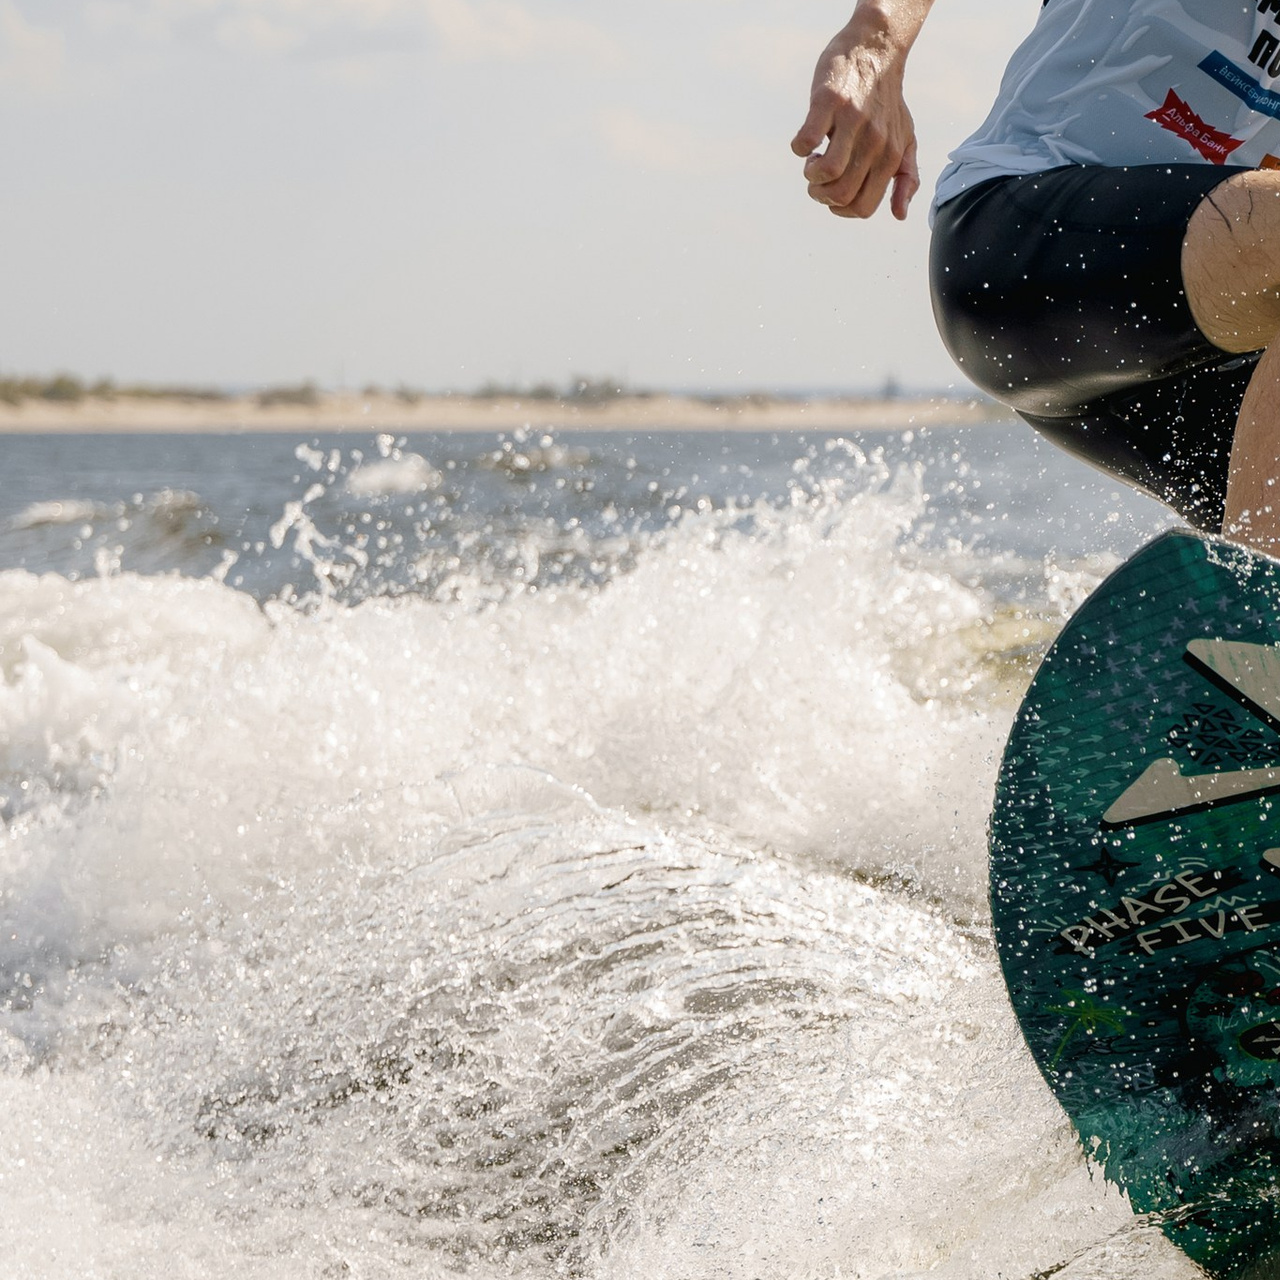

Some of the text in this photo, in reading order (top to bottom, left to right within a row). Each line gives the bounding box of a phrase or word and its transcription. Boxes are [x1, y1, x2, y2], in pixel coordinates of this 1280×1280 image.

[1163, 107, 1229, 156] Альфа Банк
[1060, 870, 1218, 956] PHASE
[1136, 904, 1270, 955] FIVE
